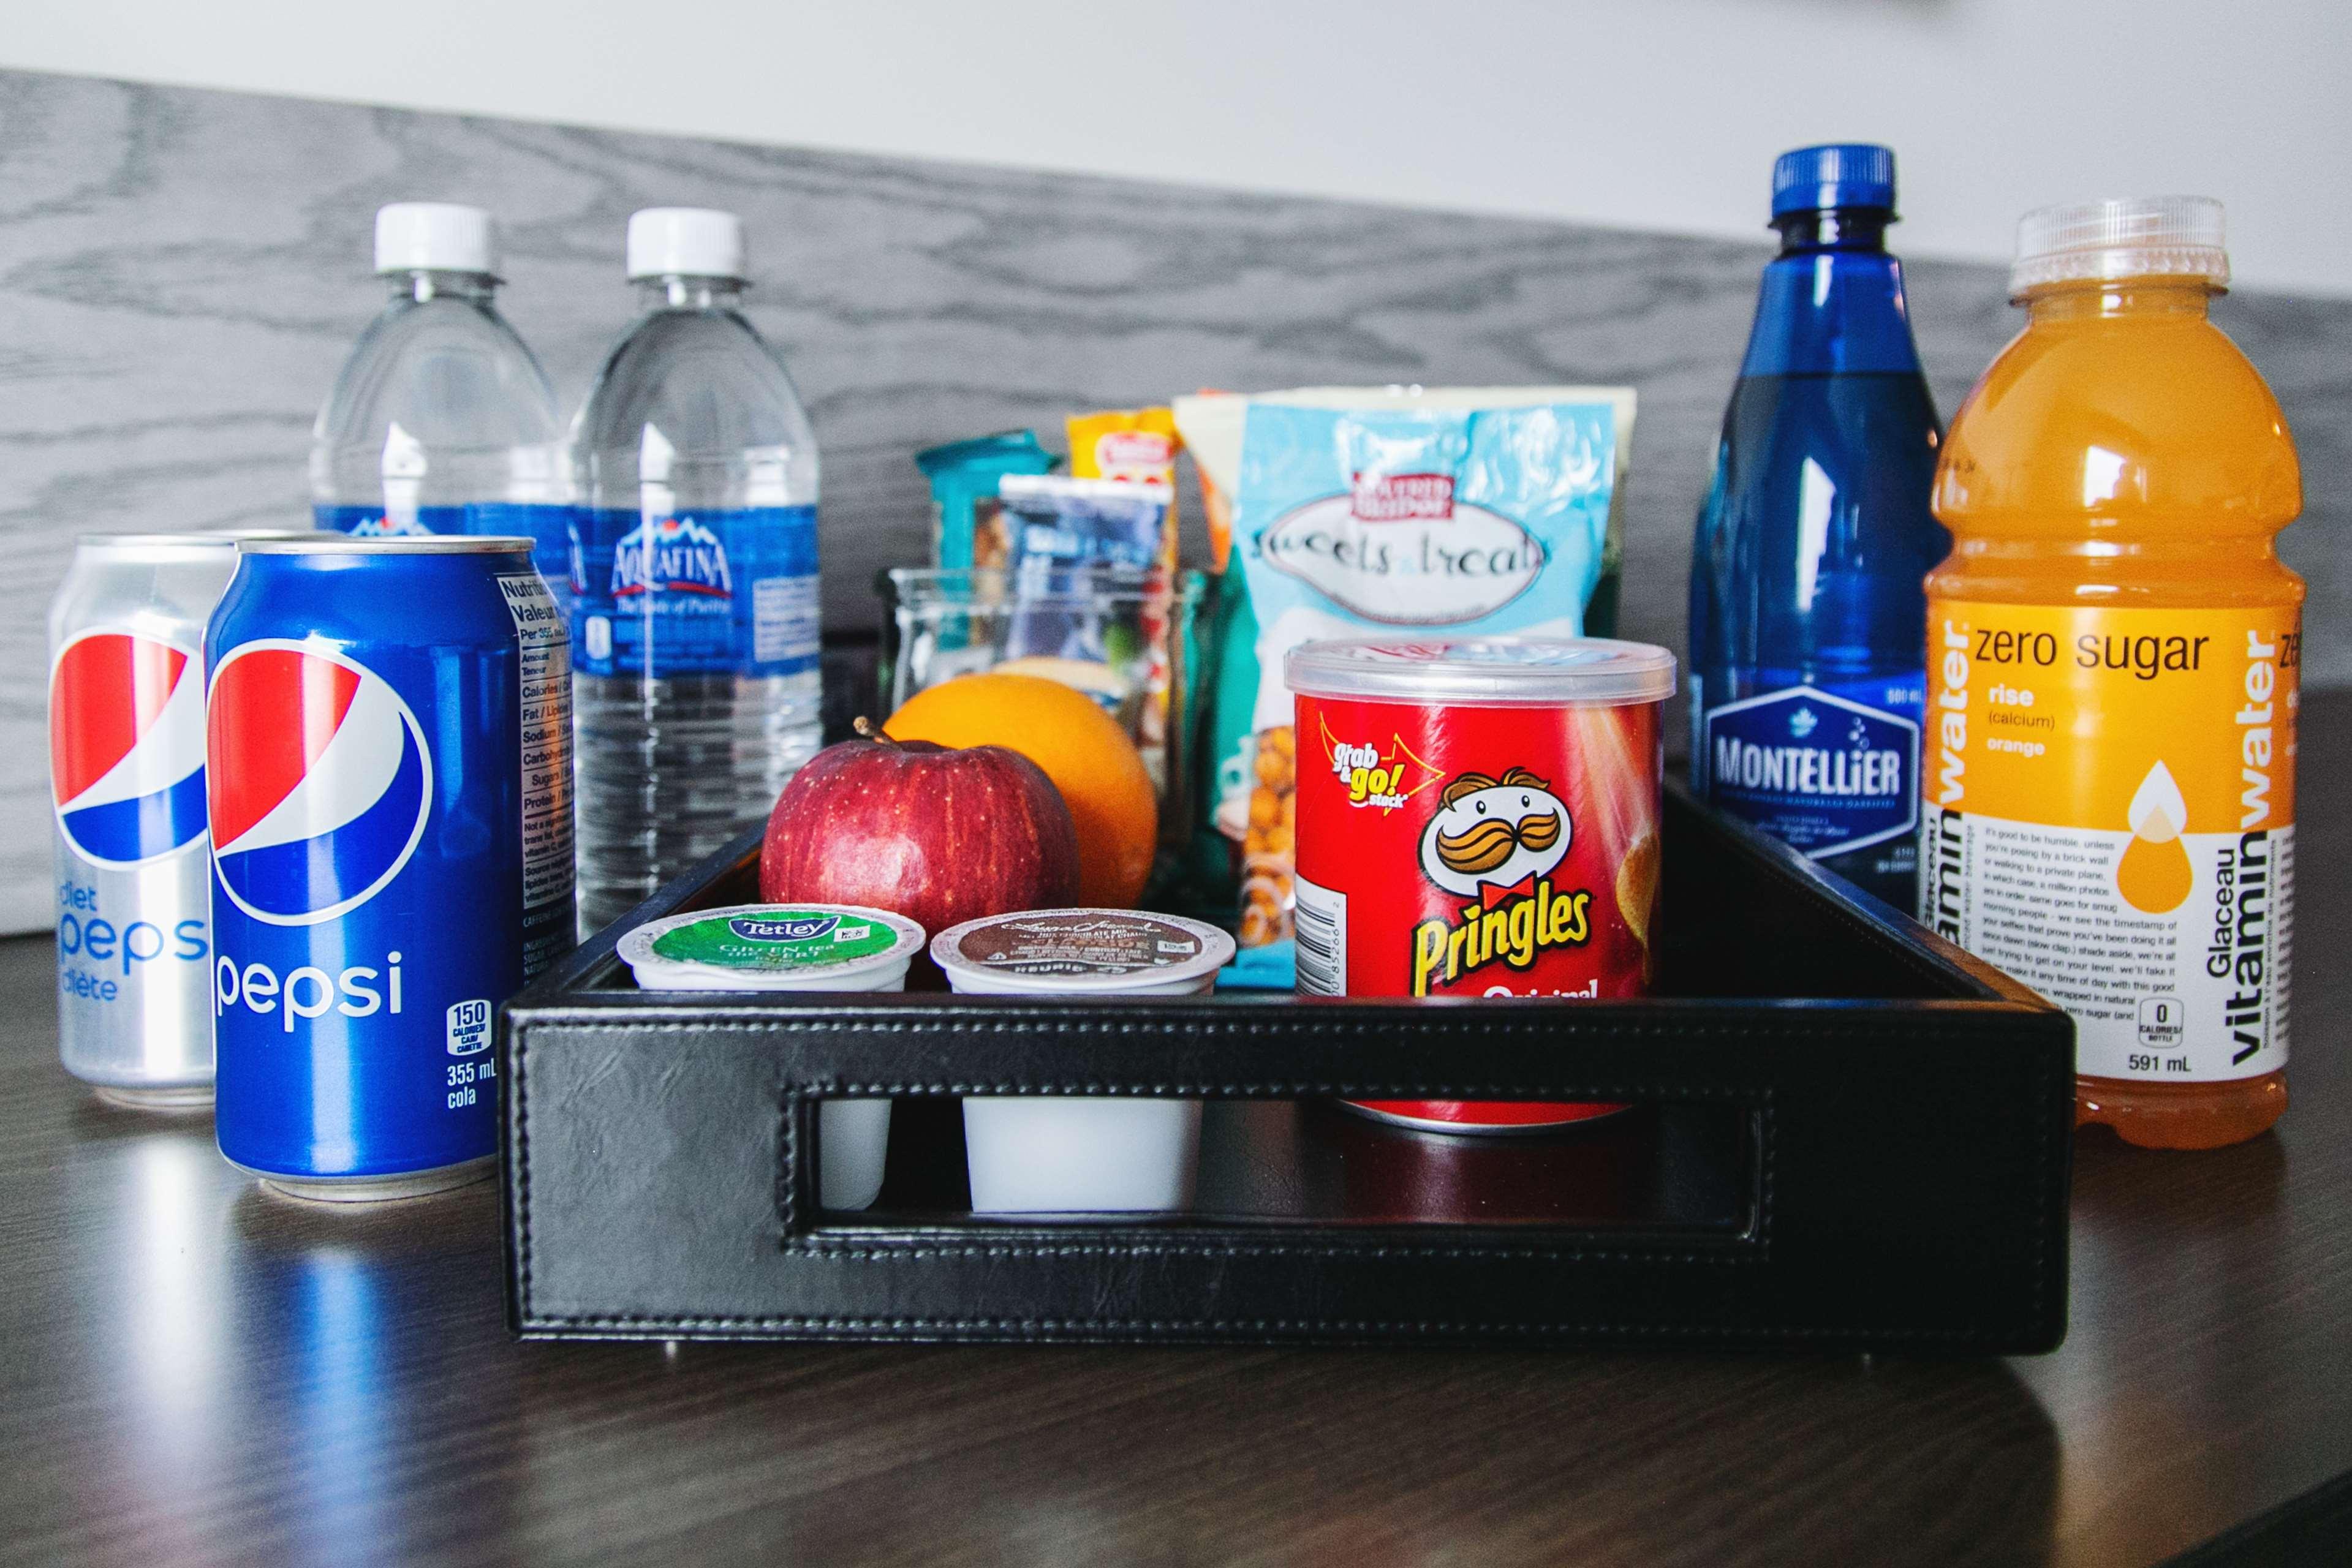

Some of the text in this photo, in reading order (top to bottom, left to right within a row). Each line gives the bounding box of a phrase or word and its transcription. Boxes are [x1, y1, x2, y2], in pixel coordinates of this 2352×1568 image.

[520, 627, 553, 640] Per 355
[522, 652, 550, 663] Amount
[1975, 628, 2210, 681] zero sugar
[522, 666, 546, 676] Teneur
[523, 683, 558, 698] Calories
[1989, 682, 2035, 708] rise
[523, 707, 539, 721] Fat
[1988, 710, 2056, 732] (calcium)
[523, 728, 557, 743] Sodium
[1333, 742, 1378, 772] grab
[1986, 736, 2045, 759] orange
[532, 771, 559, 787] Sugars
[1340, 764, 1405, 801] & go!
[524, 793, 556, 810] Protein
[1998, 830, 2018, 840] good
[2021, 832, 2028, 841] to
[2031, 834, 2041, 843] be
[2084, 840, 2116, 850] unless
[2011, 847, 2039, 859] posing
[2041, 850, 2052, 861] by
[2063, 853, 2087, 863] brick
[2089, 856, 2109, 865] wall
[525, 864, 550, 877] Source
[1994, 858, 2024, 872] walking
[2027, 864, 2035, 872] to
[2045, 866, 2075, 877] private
[2078, 870, 2106, 881] plane,
[60, 881, 97, 911] diet
[1992, 874, 2014, 884] which
[2048, 882, 2077, 892] million
[2079, 886, 2109, 895] photos
[2029, 895, 2052, 905] same
[2055, 899, 2075, 908] goes
[2079, 900, 2090, 909] for
[2092, 903, 2117, 914] smug
[2207, 849, 2235, 978] Glaceau
[744, 919, 830, 937] Tetley
[1983, 902, 2016, 916] morning
[2019, 908, 2048, 919] people
[2095, 917, 2111, 927] the
[2114, 919, 2165, 931] timestamp
[2168, 921, 2177, 930] of
[61, 913, 208, 976] peps
[1415, 881, 1590, 997] Pringles
[2000, 920, 2025, 930] selfies
[2028, 924, 2044, 933] that
[2046, 928, 2071, 937] prove
[2074, 931, 2103, 941] you've
[2106, 933, 2128, 943] been
[2131, 935, 2155, 946] doing
[2158, 937, 2164, 945] it
[2166, 937, 2177, 946] all
[1331, 929, 1340, 974] 85266
[2003, 935, 2025, 946] dawn
[2079, 947, 2106, 957] shade
[2138, 951, 2163, 960] we're
[2166, 952, 2176, 960] all
[1998, 948, 2022, 962] trying
[2025, 953, 2033, 962] to
[2068, 961, 2087, 970] your
[2146, 967, 2166, 976] fake
[2169, 967, 2176, 976] it
[63, 967, 118, 1001] diète
[2006, 965, 2029, 976] make
[2039, 972, 2055, 982] any
[2057, 973, 2078, 984] time
[2092, 978, 2108, 989] day
[2111, 981, 2130, 989] with
[2134, 981, 2150, 992] this
[2153, 984, 2175, 995] good
[217, 951, 403, 1033] pepsi
[2053, 989, 2092, 1001] wrapped
[2095, 994, 2102, 1003] in
[2104, 995, 2136, 1005] natural
[453, 1002, 485, 1026] 150
[2086, 1010, 2111, 1020] sugar
[2114, 1012, 2135, 1020] (and
[2156, 1004, 2168, 1023] 0
[2140, 1025, 2182, 1034] CALORIES/
[447, 1058, 497, 1087] 355 mL
[2128, 1054, 2192, 1072] 591 mL
[448, 1086, 476, 1109] cola
